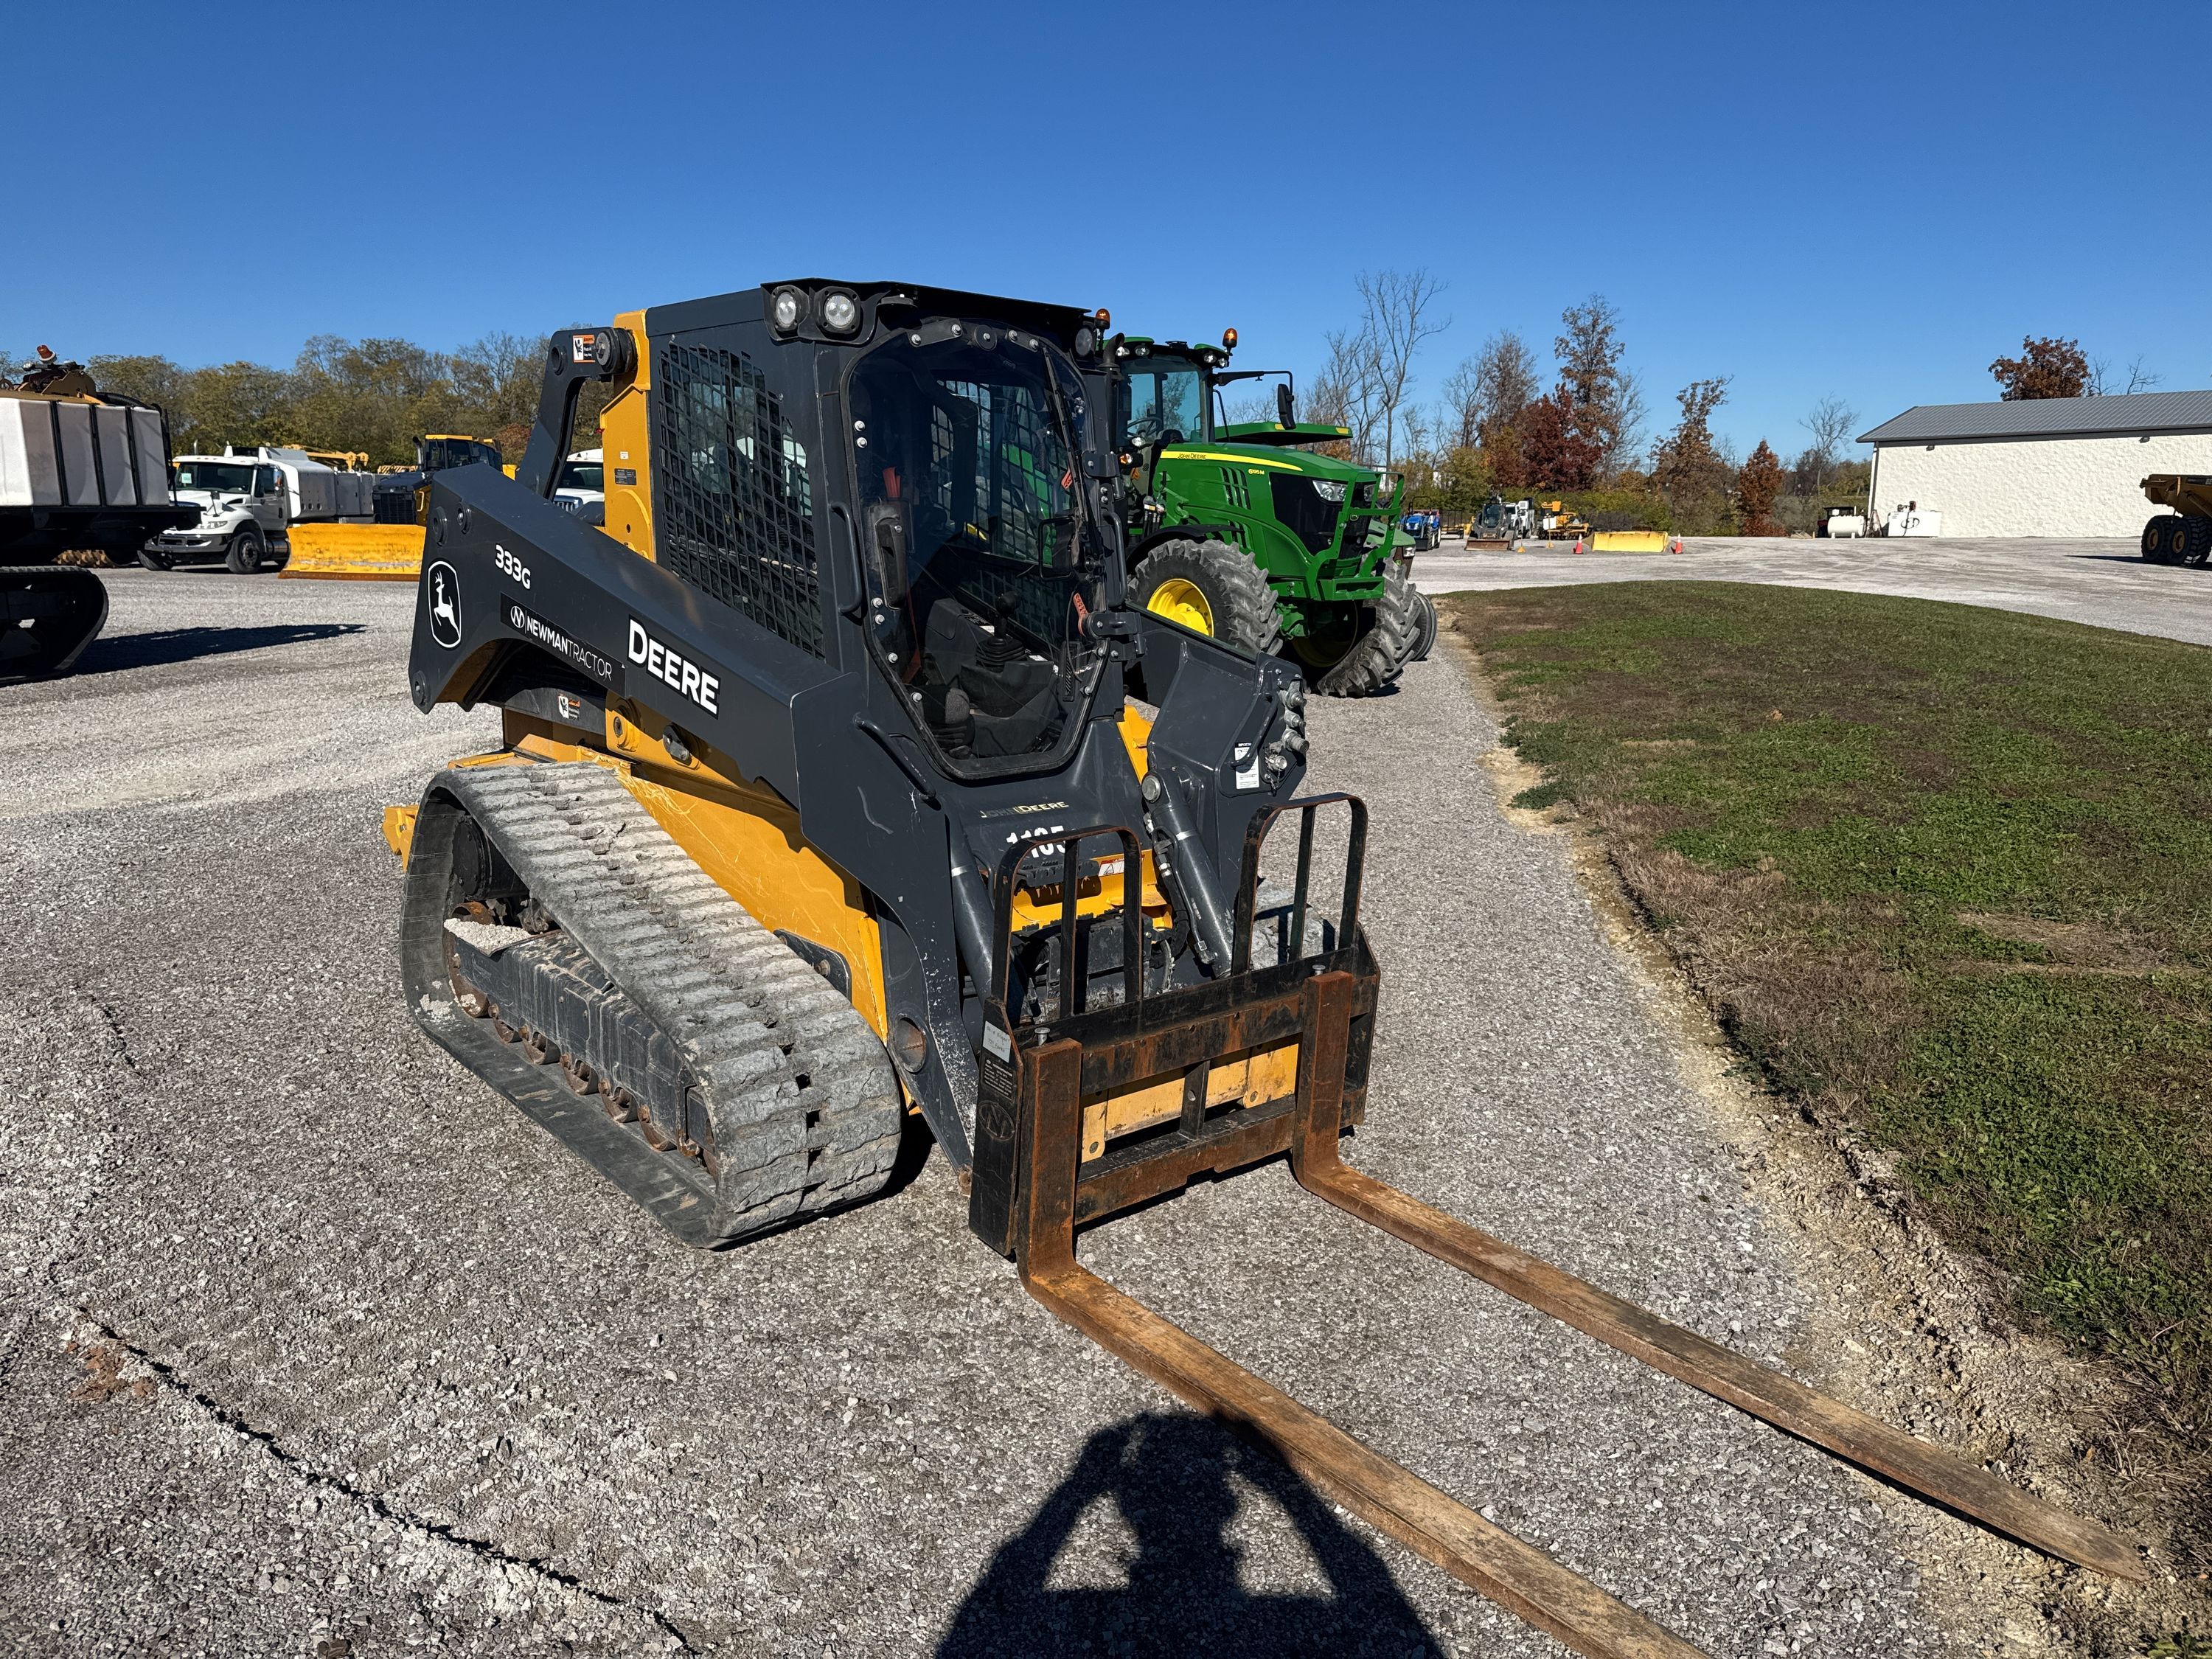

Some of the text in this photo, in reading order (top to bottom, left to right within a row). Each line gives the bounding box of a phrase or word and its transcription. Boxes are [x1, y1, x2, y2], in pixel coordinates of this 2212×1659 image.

[495, 544, 531, 589] 333G
[526, 616, 612, 682] NEWMANTRACTOR
[628, 619, 719, 714] DEERE
[1017, 801, 1070, 814] DEERE
